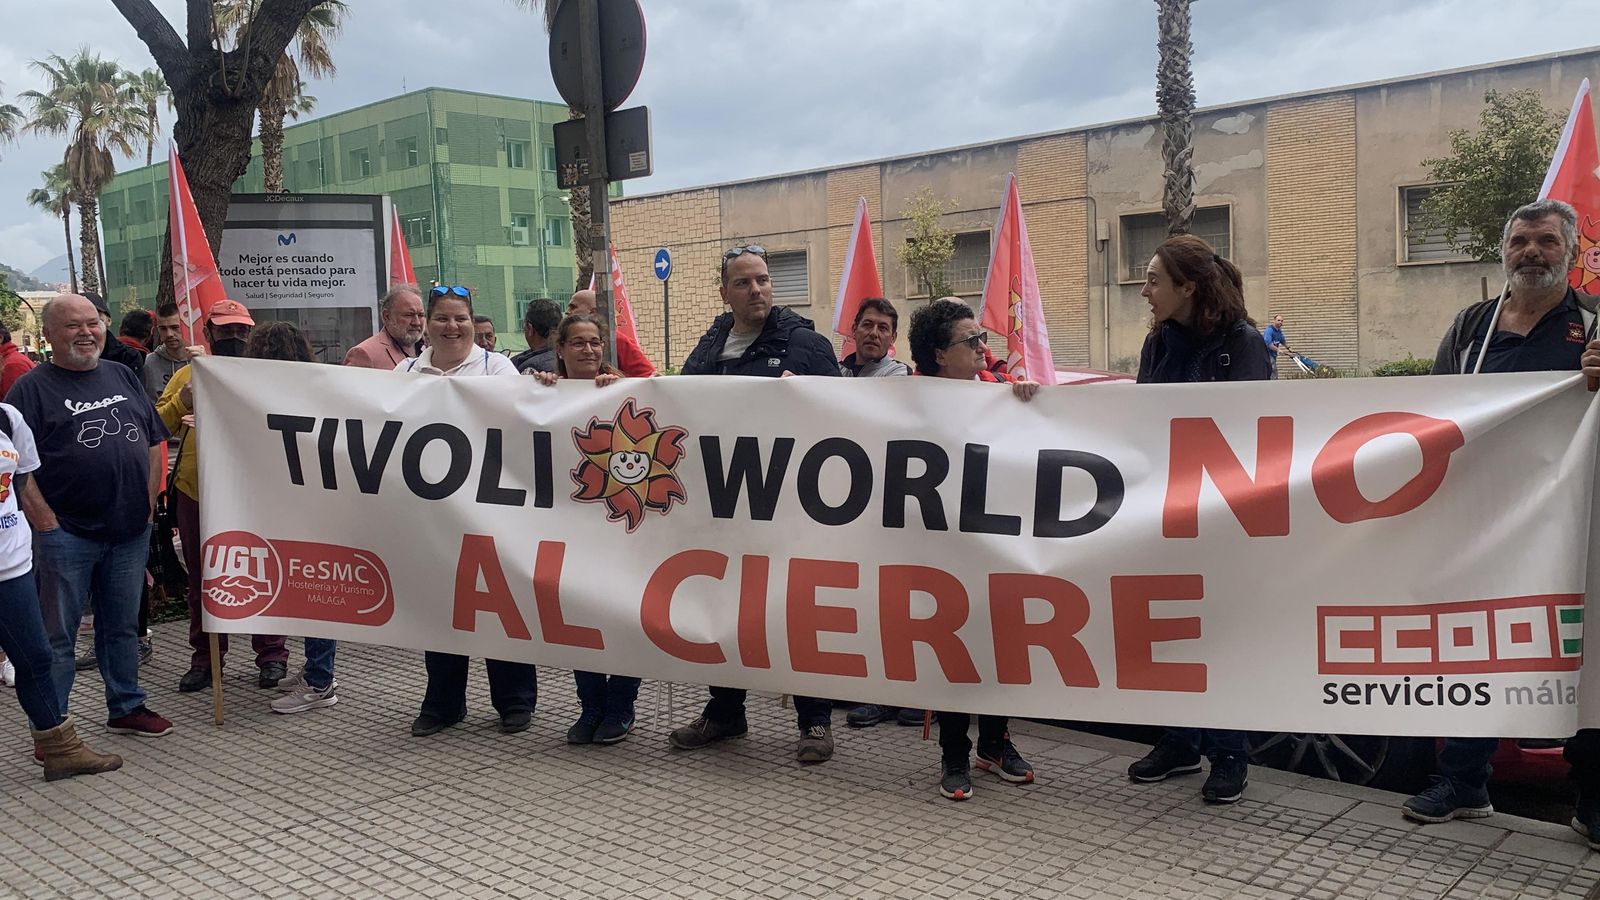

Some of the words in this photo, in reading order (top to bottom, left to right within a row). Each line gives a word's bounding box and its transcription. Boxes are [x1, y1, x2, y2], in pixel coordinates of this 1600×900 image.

[265, 194, 304, 202] JCDecaux
[239, 253, 273, 266] Mejor
[275, 255, 288, 264] es
[291, 252, 335, 264] cuando
[219, 265, 246, 276] todo
[248, 264, 274, 276] está
[277, 265, 327, 277] pensado
[330, 266, 356, 277] para
[233, 278, 265, 288] hacer
[268, 278, 280, 287] tu
[282, 277, 308, 287] vida
[311, 277, 346, 289] mejor.
[269, 291, 303, 300] Seguridad
[308, 291, 335, 300] Seguros
[64, 395, 128, 416] Vespa
[267, 413, 553, 508] TIVOLI
[699, 435, 1125, 538] WORLD
[1162, 411, 1465, 538] NO
[202, 543, 269, 582] UGT
[288, 557, 370, 584] FeSMC
[340, 582, 375, 596] Turismo
[452, 533, 605, 650] AL
[640, 549, 1208, 693] CIERRE
[1324, 605, 1553, 664] CCOO
[1322, 675, 1491, 706] servicios
[1504, 679, 1580, 706] mála
